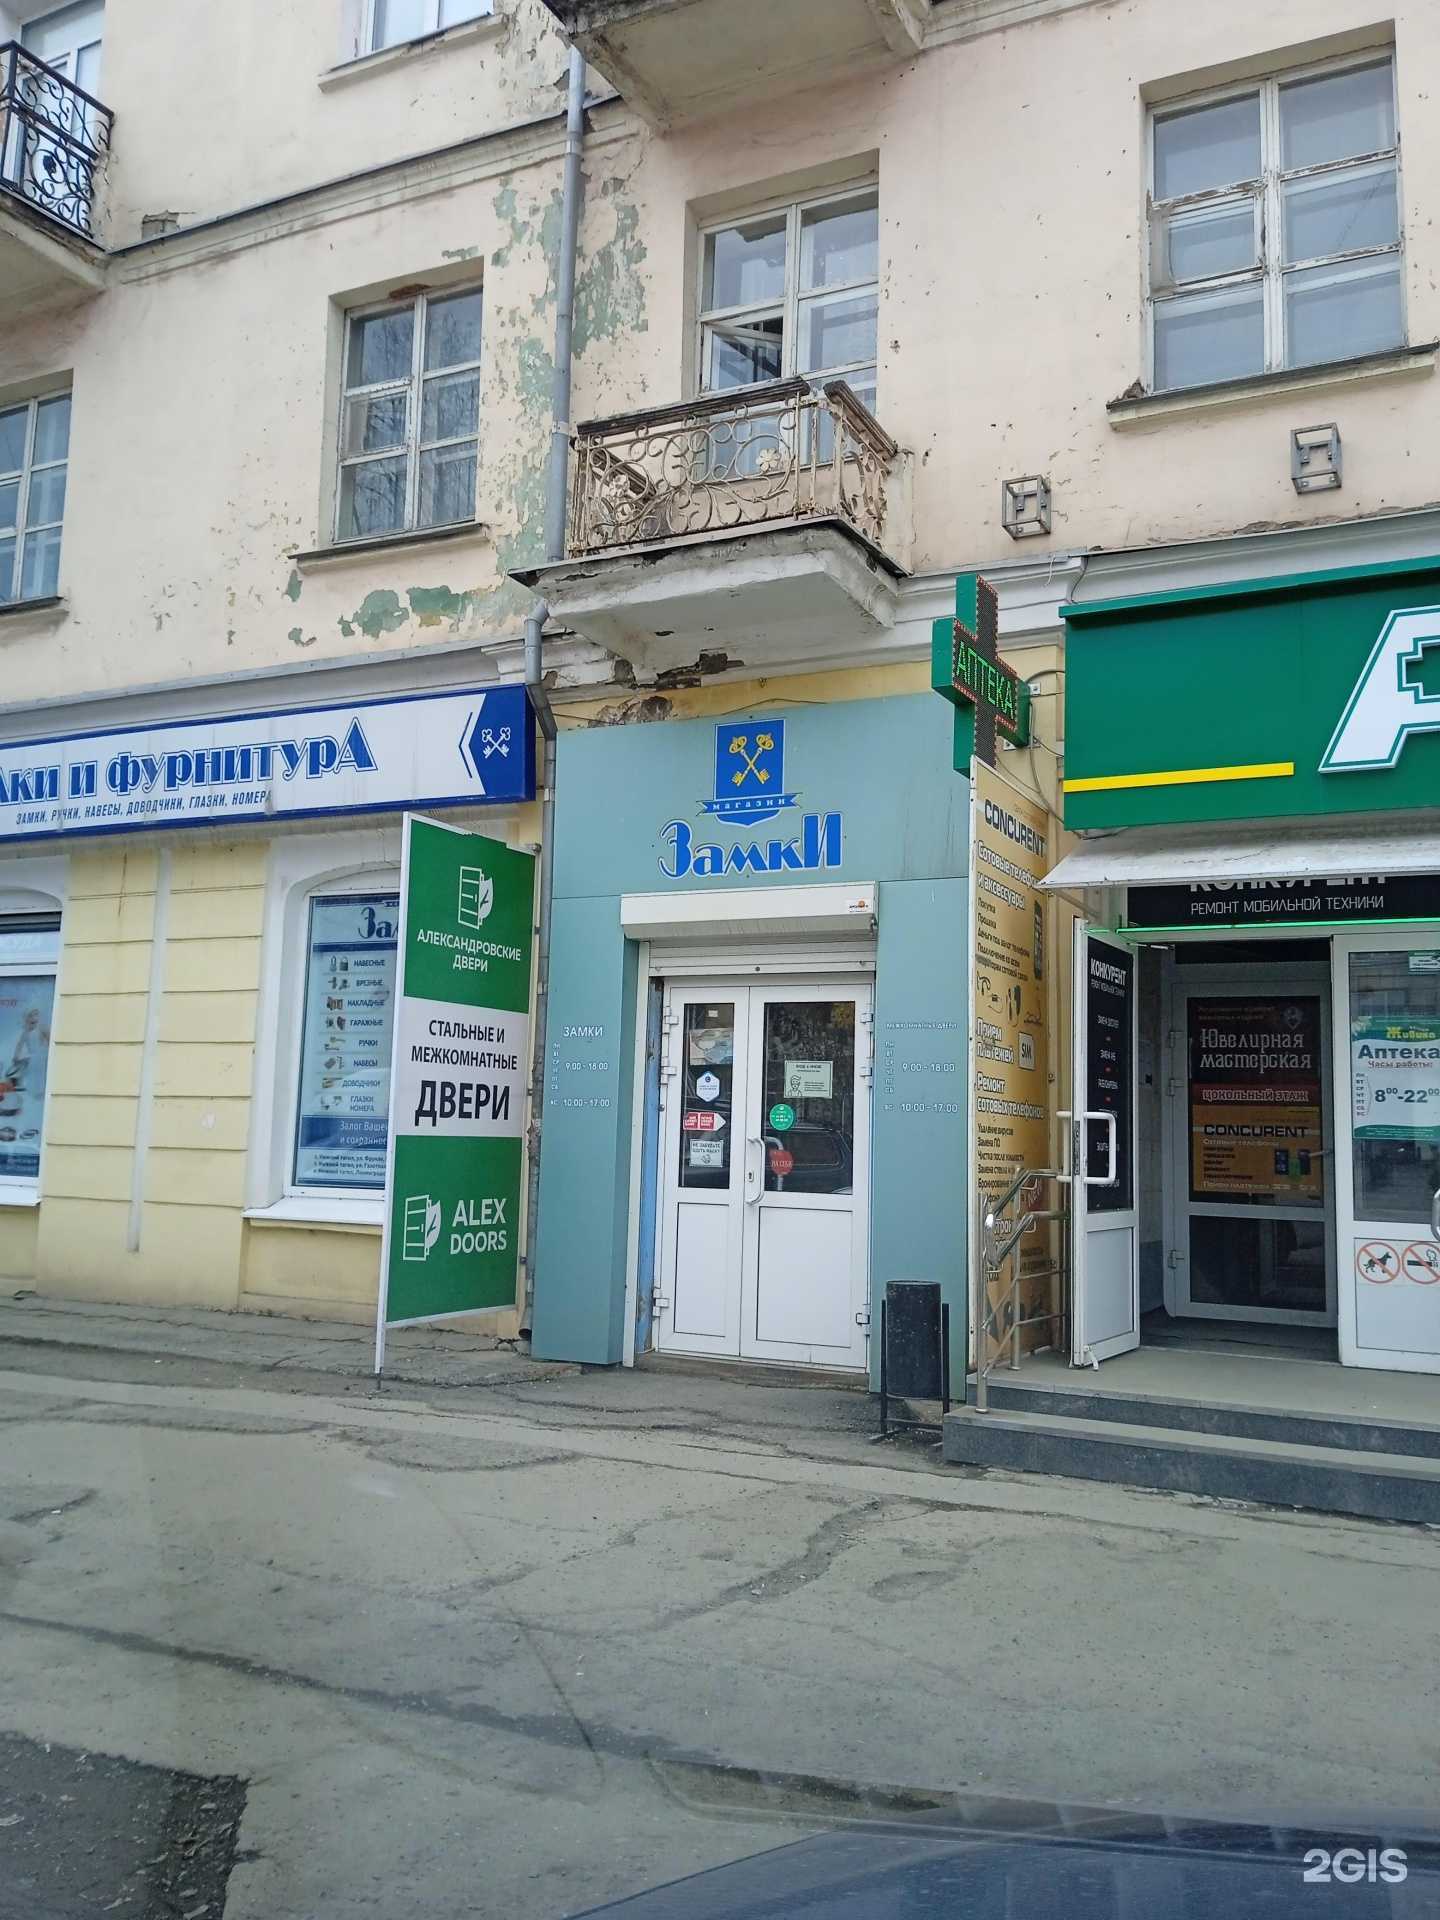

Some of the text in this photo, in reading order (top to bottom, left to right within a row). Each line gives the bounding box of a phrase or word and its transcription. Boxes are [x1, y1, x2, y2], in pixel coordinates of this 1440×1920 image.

[956, 641, 1014, 719] АПТЕКА
[16, 812, 47, 825] ЗАМКИ,
[51, 809, 81, 821] РУЧКИ,
[84, 805, 123, 818] НАВЕСЫ,
[126, 799, 185, 815] ДОВОДЧИКИ,
[712, 798, 786, 811] магазин
[984, 799, 1045, 857] CONCURENT
[984, 876, 1025, 911] аксессуары
[1191, 895, 1384, 915] РЕМОНТ МОБИЛЬНОЙ ТЕХНИКИ
[416, 928, 521, 961] АЛЕКСАНДРОВСКИЕ
[452, 954, 488, 972] ДВЕРИ
[1090, 958, 1127, 986] КОНКУРЕНТ
[428, 1019, 505, 1043] СТАЛЬНЫЕ И
[563, 1026, 603, 1037] ЗАМКИ
[1200, 1028, 1304, 1054] Ювелирная
[411, 1045, 517, 1070] МЕЖКОМНАТНЫЕ
[1200, 1053, 1312, 1074] мастерская
[1357, 1044, 1440, 1059] Аптека
[1367, 1061, 1394, 1069] Часы
[976, 1071, 1005, 1093] Ремонт
[414, 1080, 510, 1127] ДВЕРИ
[1202, 1088, 1310, 1102] ЦОКОЛЬНЫЙ ЭТАЖ
[1204, 1124, 1309, 1138] CONCURENT
[452, 1198, 507, 1227] ALEX
[450, 1230, 507, 1255] DOORS
